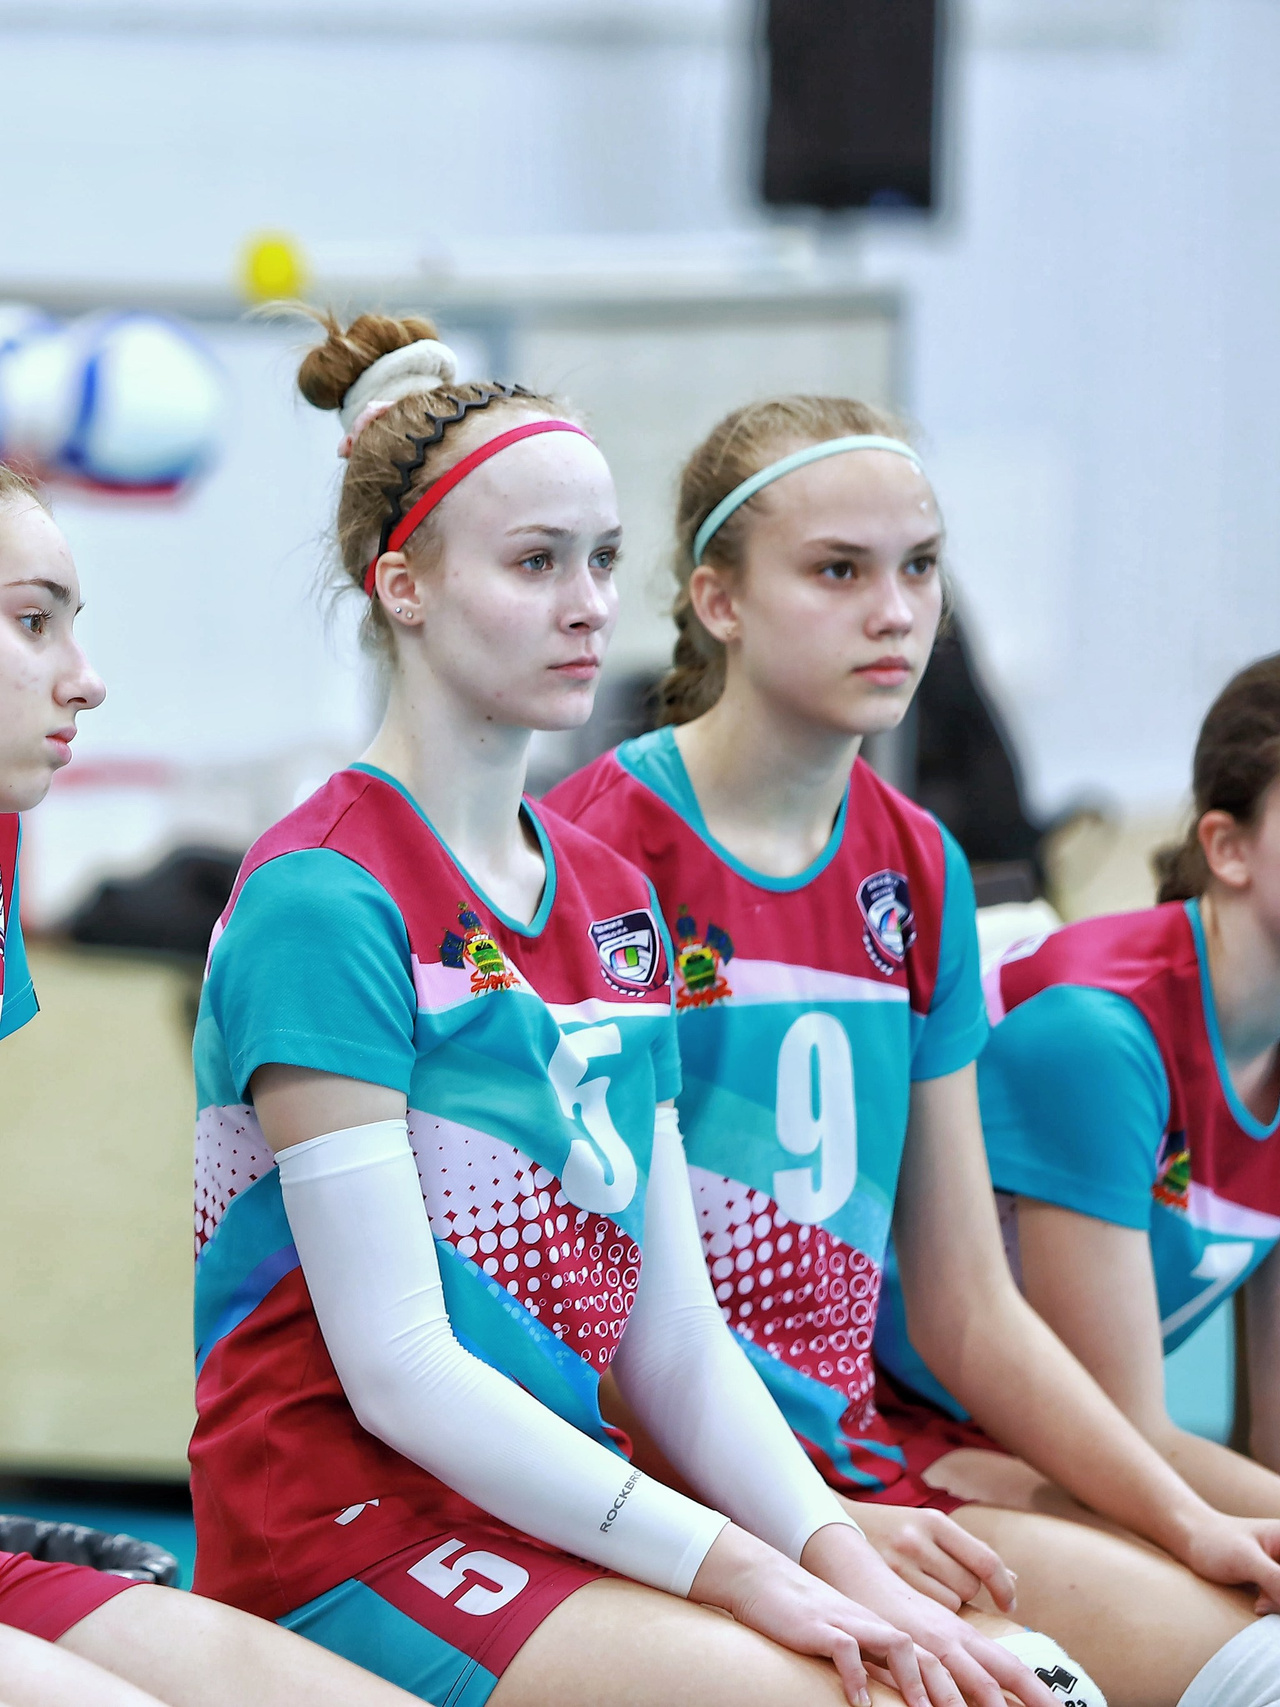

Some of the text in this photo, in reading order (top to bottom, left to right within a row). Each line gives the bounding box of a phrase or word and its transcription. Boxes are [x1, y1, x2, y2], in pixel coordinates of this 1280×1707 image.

[548, 1013, 637, 1214] 5
[773, 1011, 858, 1225] 9
[406, 1537, 530, 1616] 5
